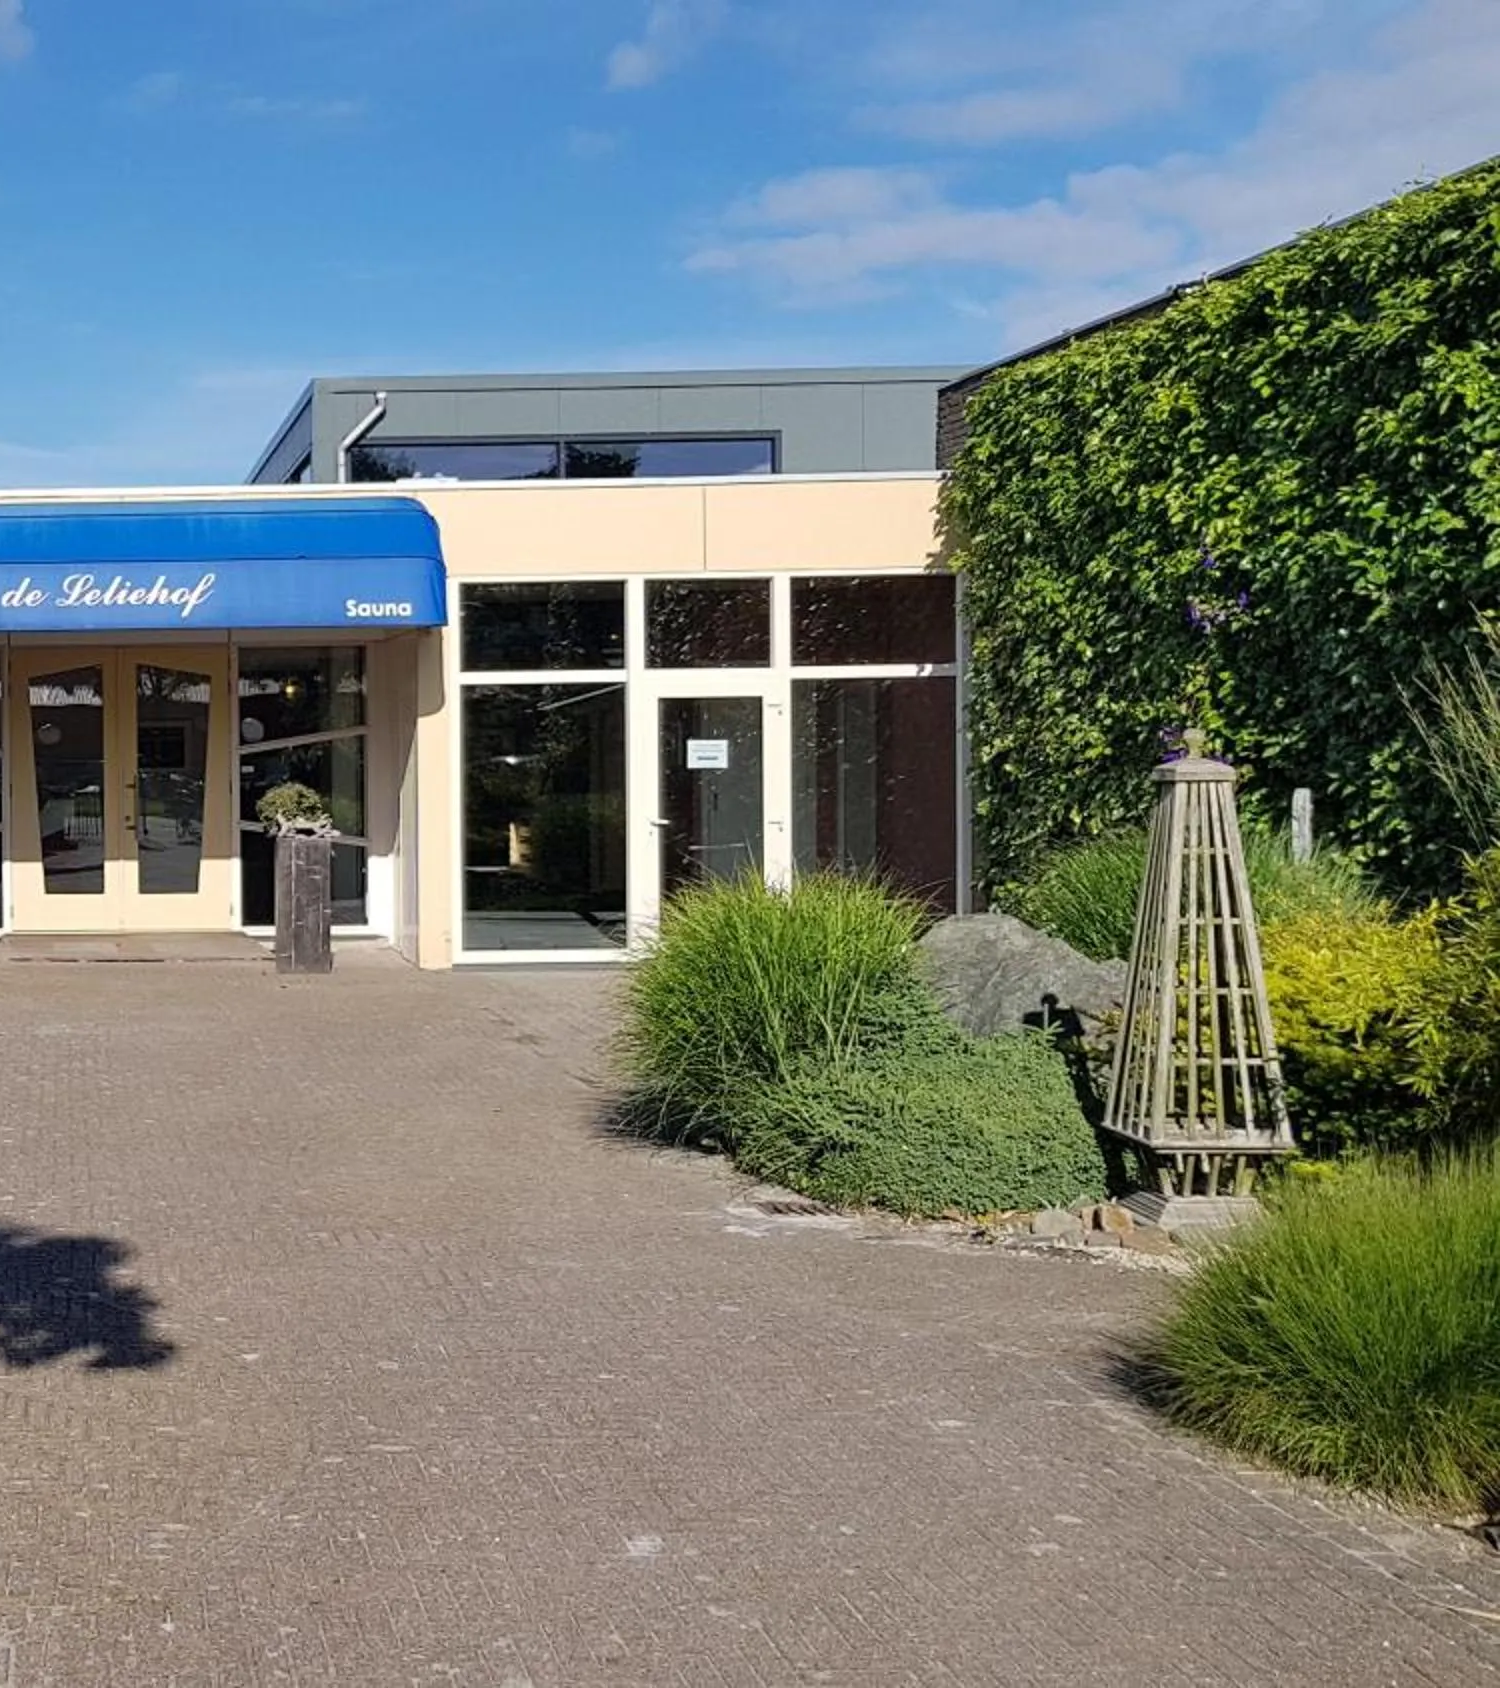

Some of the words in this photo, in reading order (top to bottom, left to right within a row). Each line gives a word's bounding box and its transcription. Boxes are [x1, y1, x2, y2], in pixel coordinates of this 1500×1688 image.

[0, 577, 50, 608] de
[55, 573, 216, 618] Leliehof
[345, 599, 413, 617] Sauna
